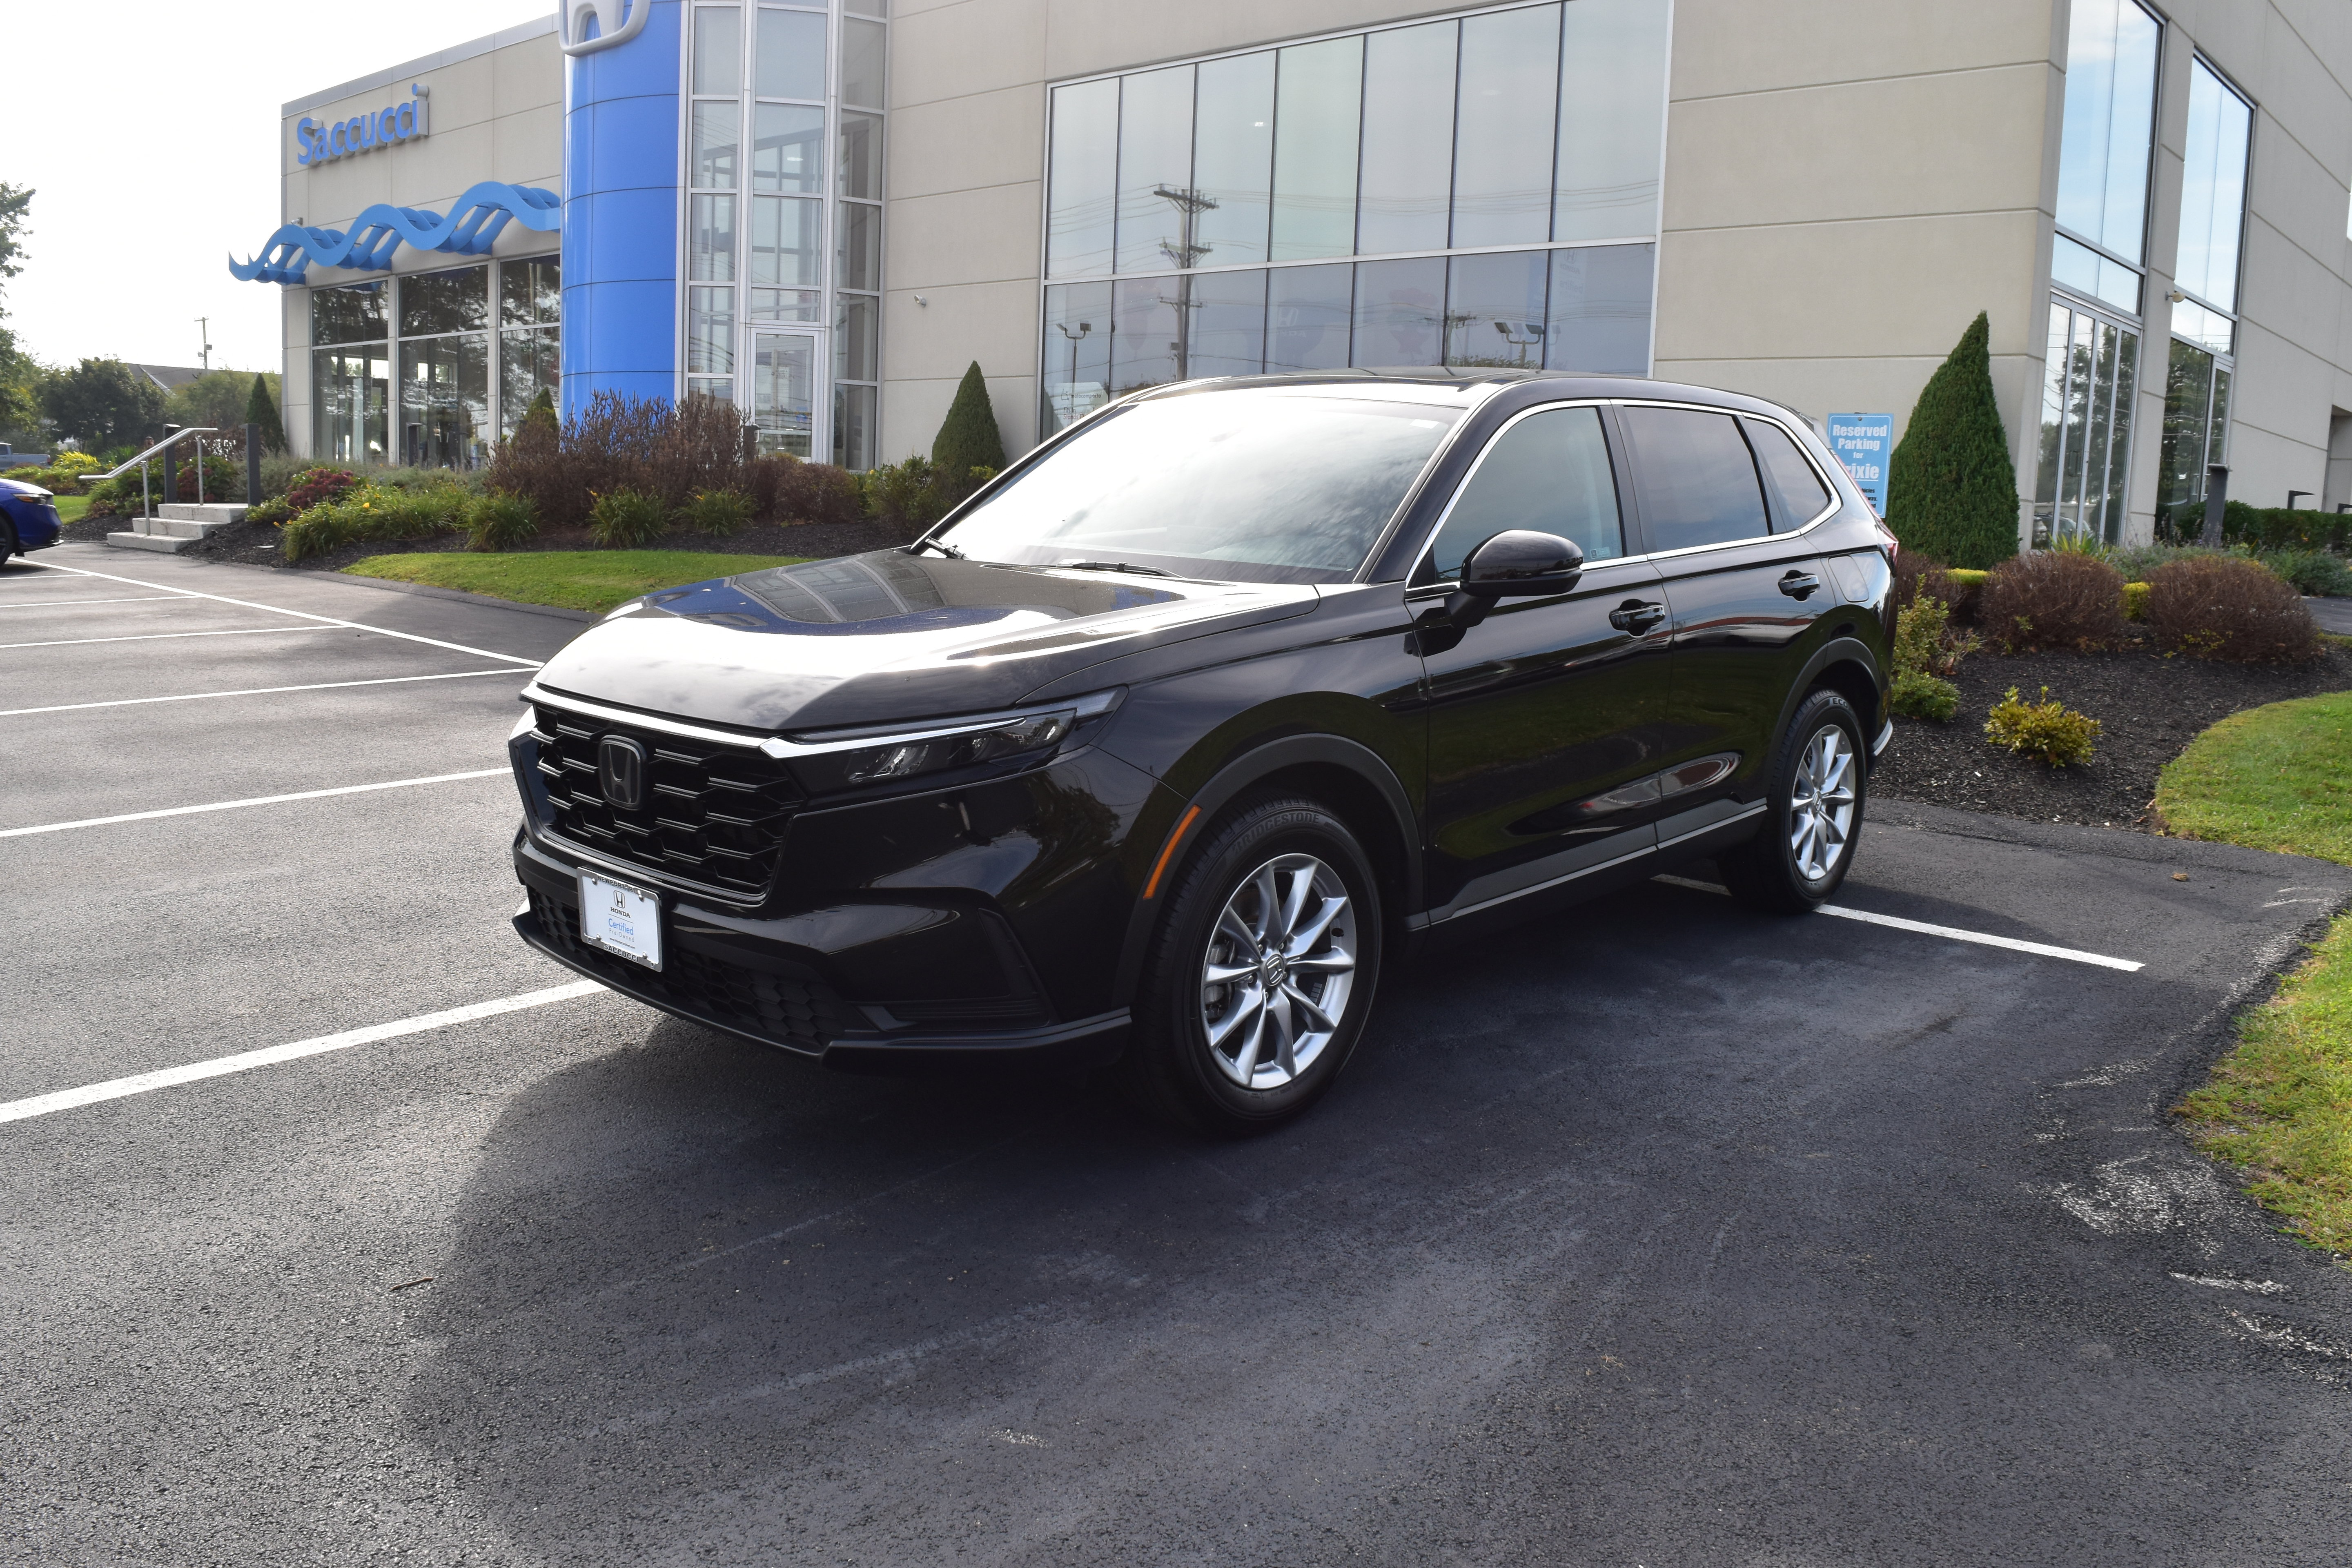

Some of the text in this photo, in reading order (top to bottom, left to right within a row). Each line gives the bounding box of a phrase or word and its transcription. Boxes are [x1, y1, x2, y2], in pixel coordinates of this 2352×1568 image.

[297, 83, 422, 166] Saccucci
[1833, 424, 1887, 437] Reserved
[1838, 438, 1880, 451] Parking
[1232, 811, 1319, 855] BRIDGESTONE
[610, 907, 631, 918] HONDA
[608, 918, 634, 935] Certified
[609, 928, 634, 942] Pre-Owned
[604, 943, 639, 962] SACCUCCI
